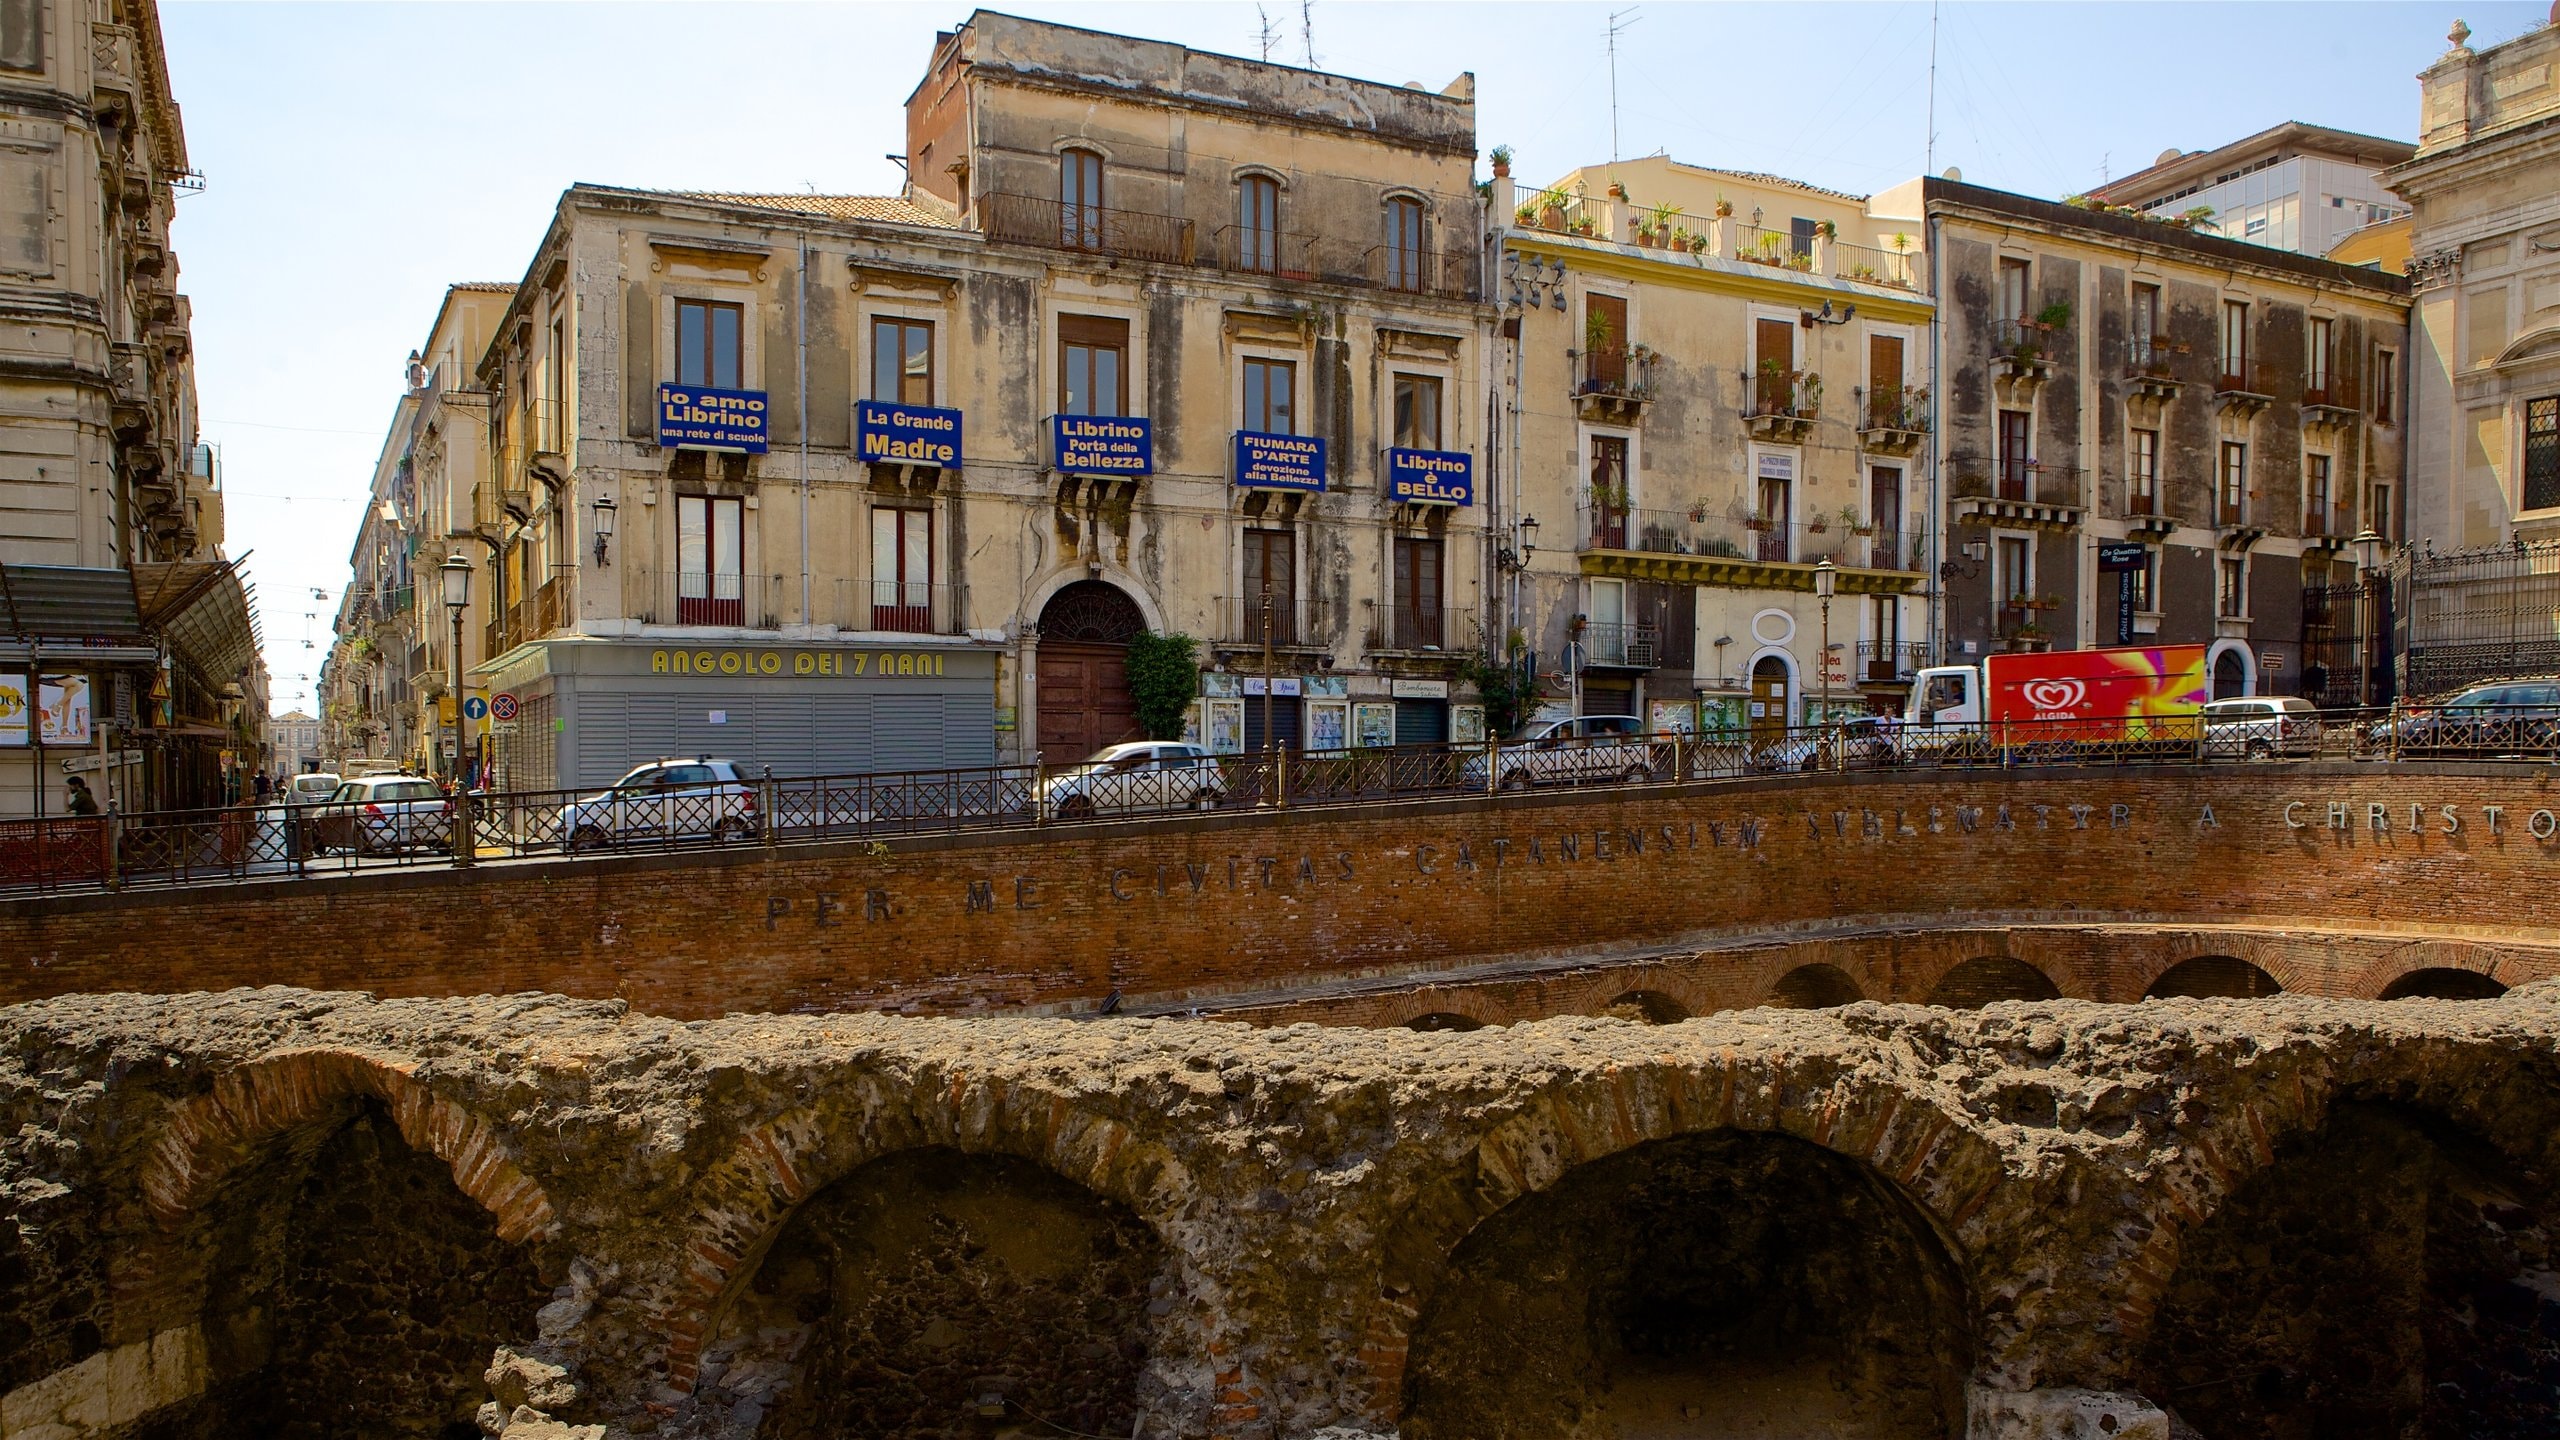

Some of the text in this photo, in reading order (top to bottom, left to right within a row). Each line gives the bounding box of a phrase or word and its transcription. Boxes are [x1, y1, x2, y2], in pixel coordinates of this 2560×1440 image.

[661, 389, 765, 412] io amo
[666, 404, 761, 429] Librino
[867, 408, 954, 431] La Grande
[661, 428, 766, 443] una rete di scuole
[1062, 420, 1144, 439] Librino
[865, 433, 954, 462] Madre
[1069, 439, 1138, 453] Porta della
[1243, 436, 1318, 453] FIUMARA
[1063, 451, 1145, 469] Bellezza
[1252, 449, 1310, 465] D'ARTE
[1396, 453, 1466, 473] Librino
[1252, 462, 1310, 476] devozione
[1424, 471, 1438, 484] è
[1245, 471, 1319, 486] alla Bellezza
[1397, 481, 1467, 500] BELLO
[652, 650, 943, 676] ANGOLO DEI 7 NANI
[2033, 712, 2076, 720] ALGIDA
[767, 889, 894, 932] PER
[966, 876, 1041, 915] ME
[1111, 851, 1356, 900] CIVITAS
[2199, 802, 2221, 828] A
[2284, 801, 2557, 839] CHRISTO
